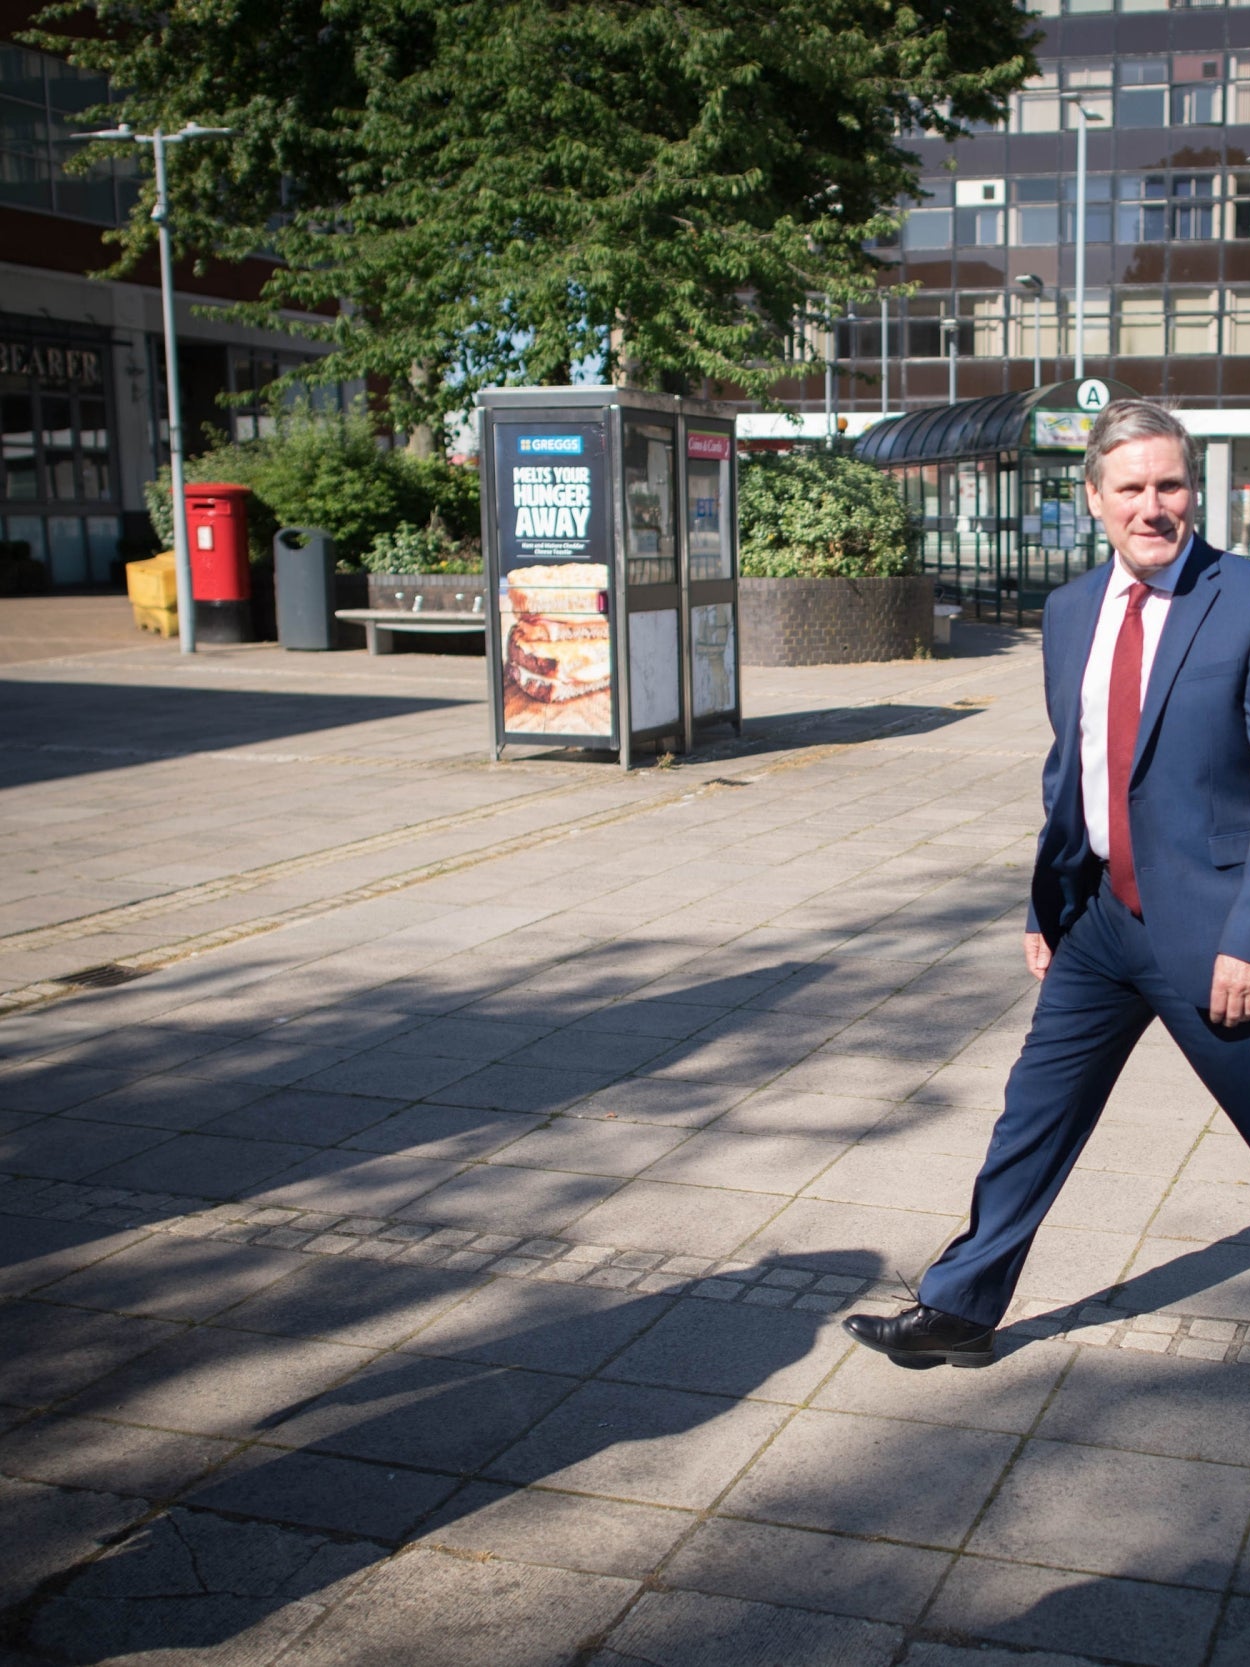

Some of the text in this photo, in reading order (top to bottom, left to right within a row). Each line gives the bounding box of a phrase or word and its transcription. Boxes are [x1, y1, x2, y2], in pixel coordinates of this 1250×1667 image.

[1086, 386, 1100, 405] A
[531, 439, 579, 450] GREGGS
[513, 466, 591, 483] MELTS YOUR
[513, 484, 591, 507] HUNGER
[697, 498, 713, 517] BT
[515, 507, 592, 537] AWAY
